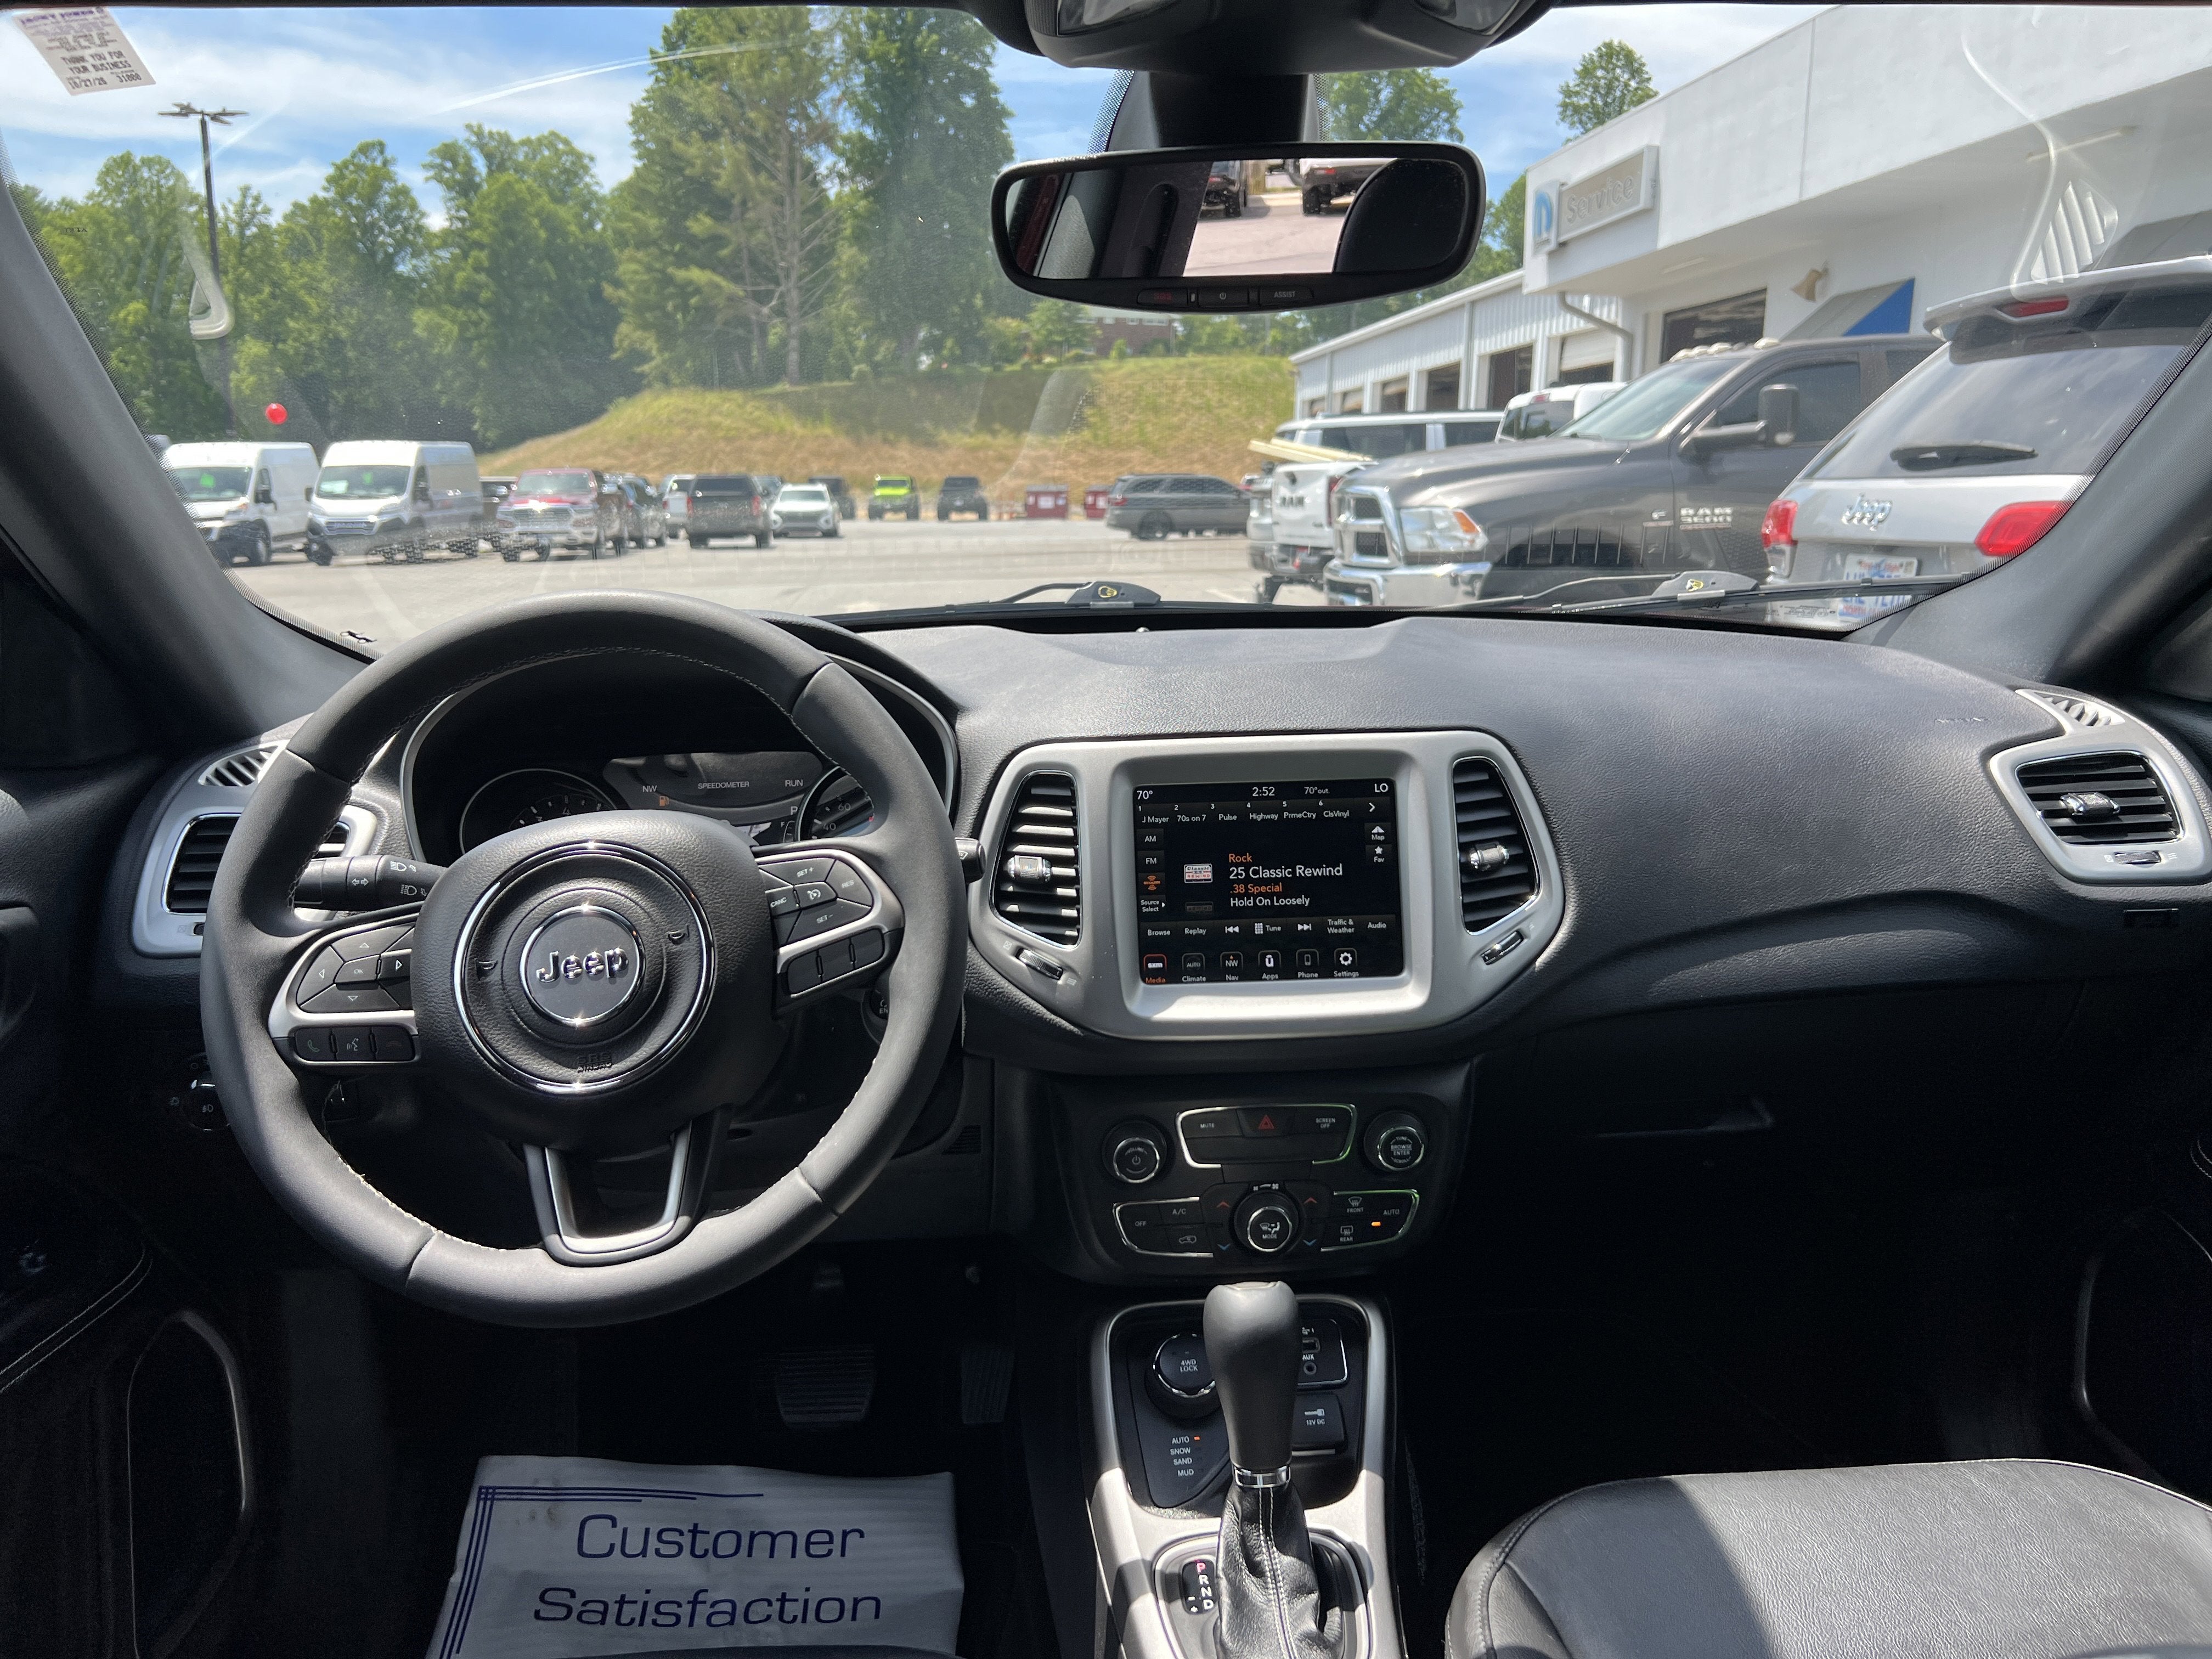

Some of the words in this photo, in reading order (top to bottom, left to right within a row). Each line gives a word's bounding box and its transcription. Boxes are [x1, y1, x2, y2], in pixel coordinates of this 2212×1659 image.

[90, 53, 107, 61] YOU
[108, 50, 126, 59] FOR
[91, 60, 132, 72] BUSINESS
[1566, 174, 1635, 223] Service
[1680, 507, 1734, 516] RAM
[1841, 495, 1892, 531] Jeep
[697, 781, 750, 789] SPEEDOMETER
[1374, 783, 1389, 793] LO
[1252, 786, 1275, 796] 2:52
[791, 806, 798, 815] P
[838, 803, 851, 811] 60
[1249, 812, 1279, 821] Highway
[1283, 811, 1317, 820] PrmeCtry
[1323, 810, 1350, 819] ClsVinyl
[1148, 816, 1170, 824] Mayer
[1228, 853, 1252, 863] Rock
[1229, 867, 1245, 878] 25
[1249, 865, 1293, 878] Classic
[1296, 863, 1342, 877] Rewind
[842, 879, 855, 888] RES
[1230, 884, 1245, 894] .38
[1248, 882, 1282, 895] Special
[770, 896, 787, 908] CANC
[1230, 896, 1254, 907] Hold
[1256, 896, 1271, 906] On
[1274, 895, 1310, 907] Loosely
[816, 915, 828, 923] SET
[1184, 928, 1207, 936] Replay
[535, 947, 629, 983] Jeep
[1172, 1436, 1190, 1444] AUTO
[1170, 1447, 1191, 1455] SNOW
[1173, 1457, 1193, 1466] SAND
[1177, 1469, 1194, 1477] MUD
[576, 1514, 865, 1560] Customer
[1197, 1562, 1206, 1573] P
[1199, 1574, 1209, 1584] R
[1201, 1586, 1212, 1598] N
[533, 1587, 882, 1628] Satisfaction
[1203, 1599, 1214, 1610] D
